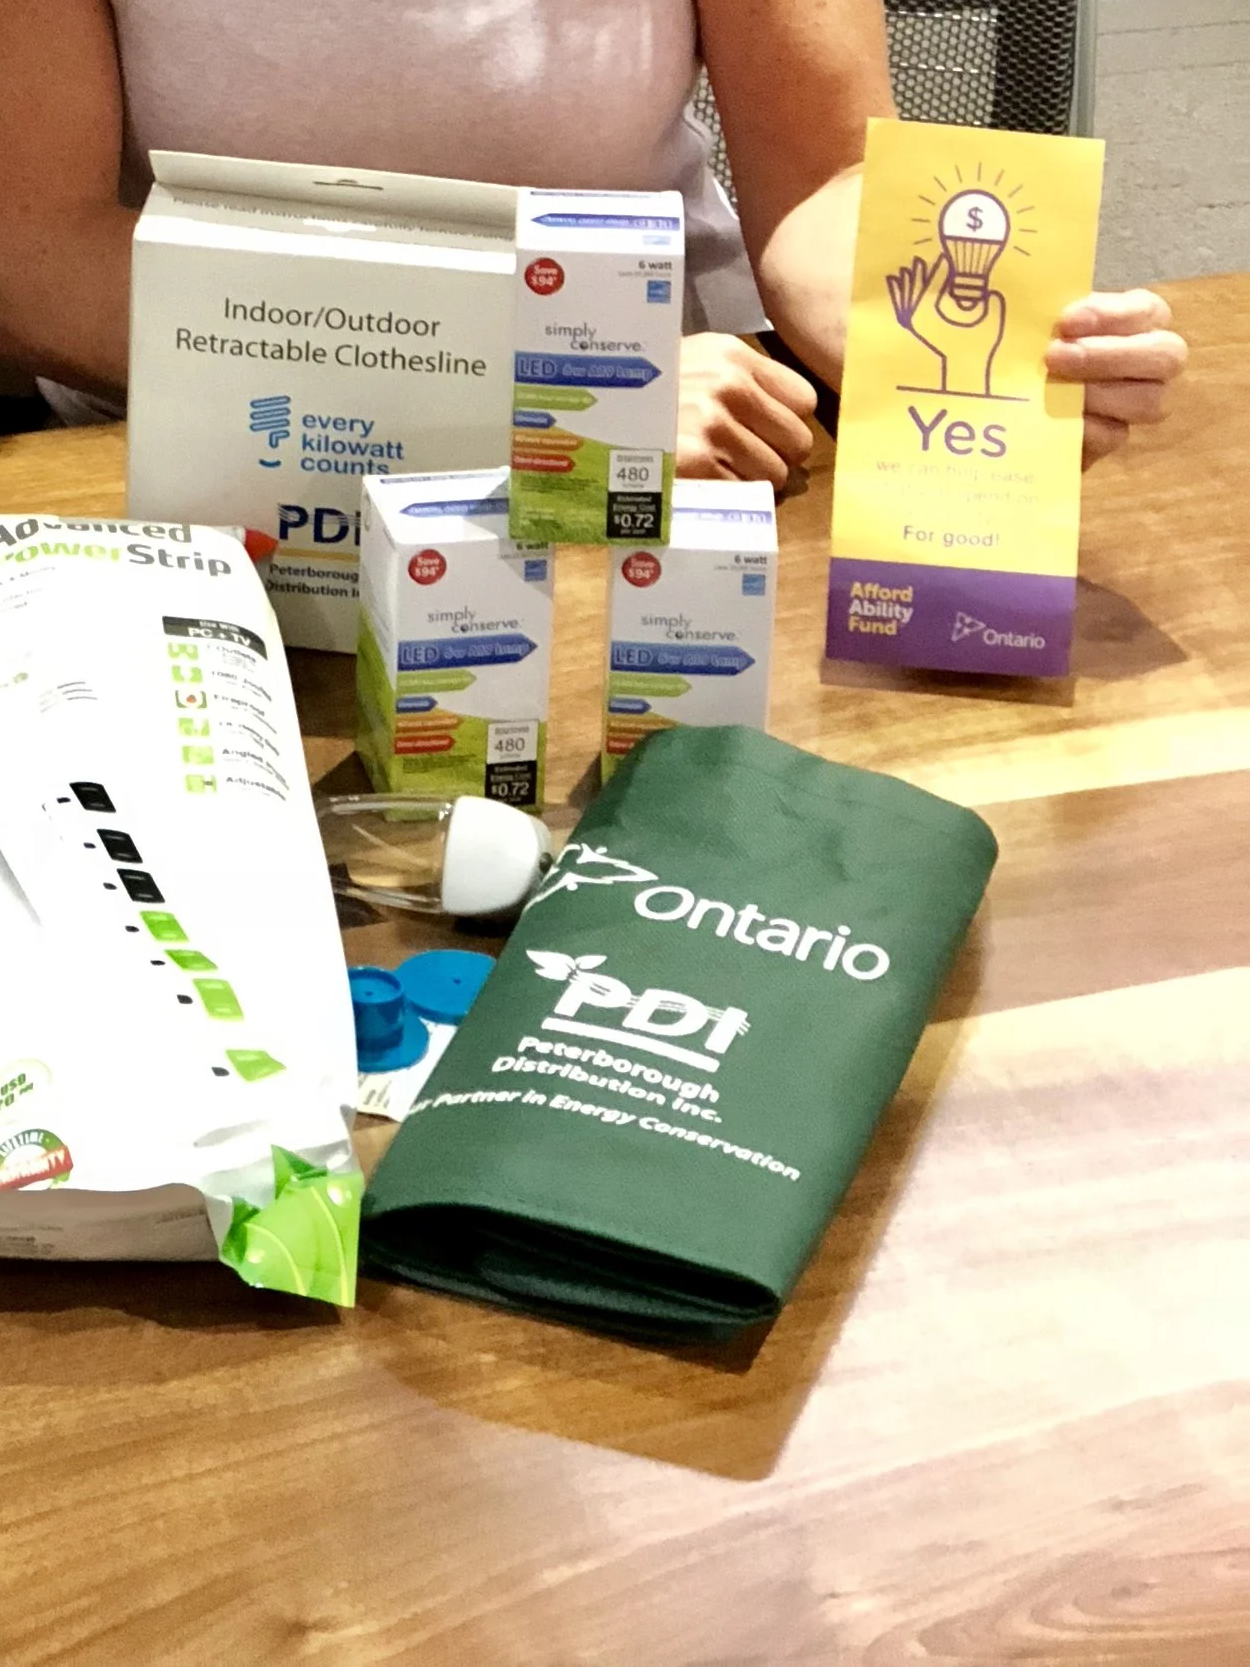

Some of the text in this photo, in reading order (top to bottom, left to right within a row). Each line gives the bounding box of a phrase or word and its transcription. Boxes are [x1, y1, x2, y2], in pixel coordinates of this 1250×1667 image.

[966, 206, 984, 232] $
[638, 260, 672, 270] 6 watt
[224, 297, 441, 337] Indoor/Outdoor
[545, 322, 597, 342] simply
[176, 328, 487, 377] Retractable Clothesline
[517, 356, 559, 378] LED
[302, 413, 375, 439] every
[907, 405, 1007, 458] Yes
[301, 433, 405, 460] kilowatt
[300, 456, 390, 475] counts
[617, 467, 649, 482] 480
[614, 514, 654, 528] $0.72
[903, 525, 1000, 547] For good!
[416, 556, 440, 567] Save
[734, 555, 768, 565] 6 watt
[270, 564, 359, 583] Peterboroug
[265, 579, 348, 597] Distribution
[850, 582, 913, 603] Afford
[427, 606, 476, 626] simply
[848, 599, 914, 624] Ability
[641, 614, 692, 633] simply
[848, 616, 898, 636] Fund
[188, 627, 251, 647] PC TV
[983, 629, 1046, 650] Ontario
[401, 645, 440, 664] LED
[614, 645, 652, 666] LED
[494, 737, 525, 752] 480
[491, 782, 530, 797] $0.72
[633, 883, 891, 983] Ontario
[517, 1034, 721, 1106] Peterborough
[491, 1054, 724, 1125] Distribution Inc.
[433, 1090, 524, 1108] Partner
[522, 1089, 548, 1106] in
[549, 1094, 637, 1129] Energy
[638, 1115, 802, 1182] Conservation
